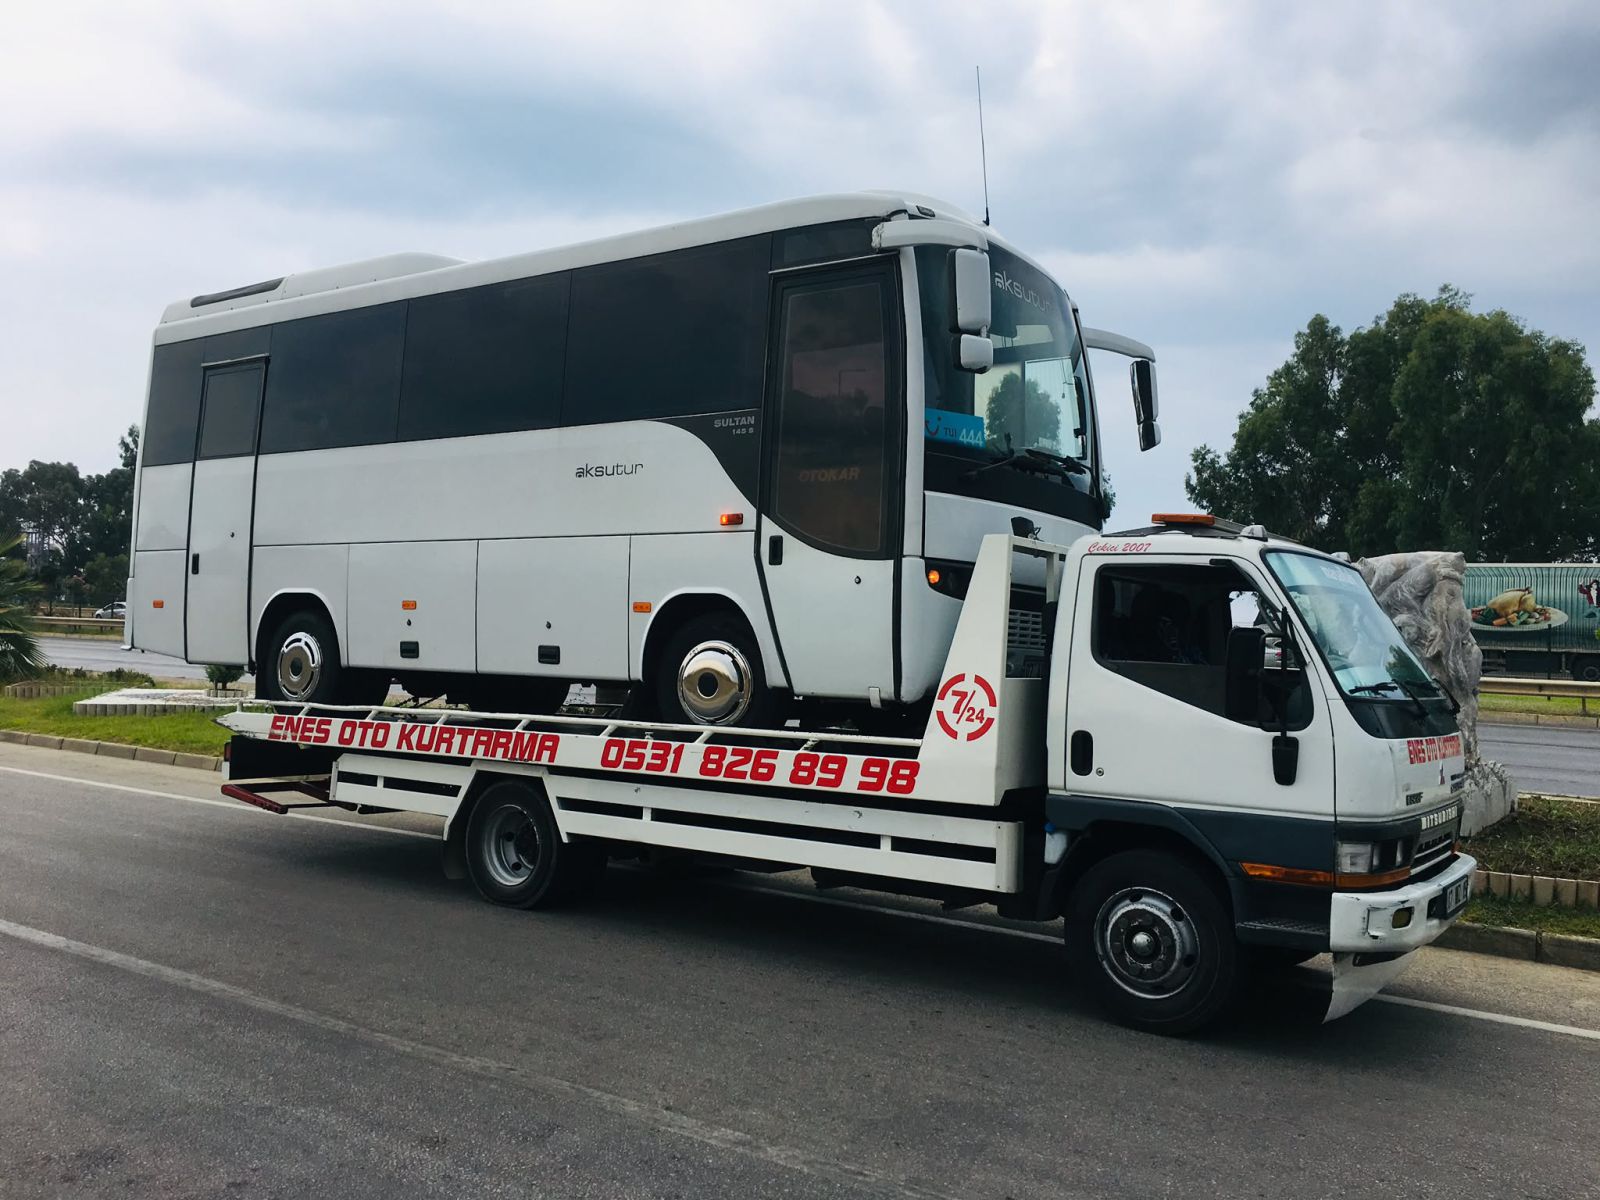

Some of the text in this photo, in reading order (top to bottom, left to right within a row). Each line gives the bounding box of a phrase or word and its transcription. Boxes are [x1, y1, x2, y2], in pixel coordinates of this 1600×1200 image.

[994, 270, 1050, 312] aksutur
[713, 415, 755, 428] SULTAN
[944, 427, 984, 447] TUI 444
[575, 463, 644, 478] aksutur
[799, 466, 860, 482] OTOKAR
[1122, 542, 1152, 552] 2007
[951, 690, 985, 725] 7/24
[267, 715, 560, 763] ENES OTO KURTARMA
[600, 738, 921, 794] 0531 826 89 98
